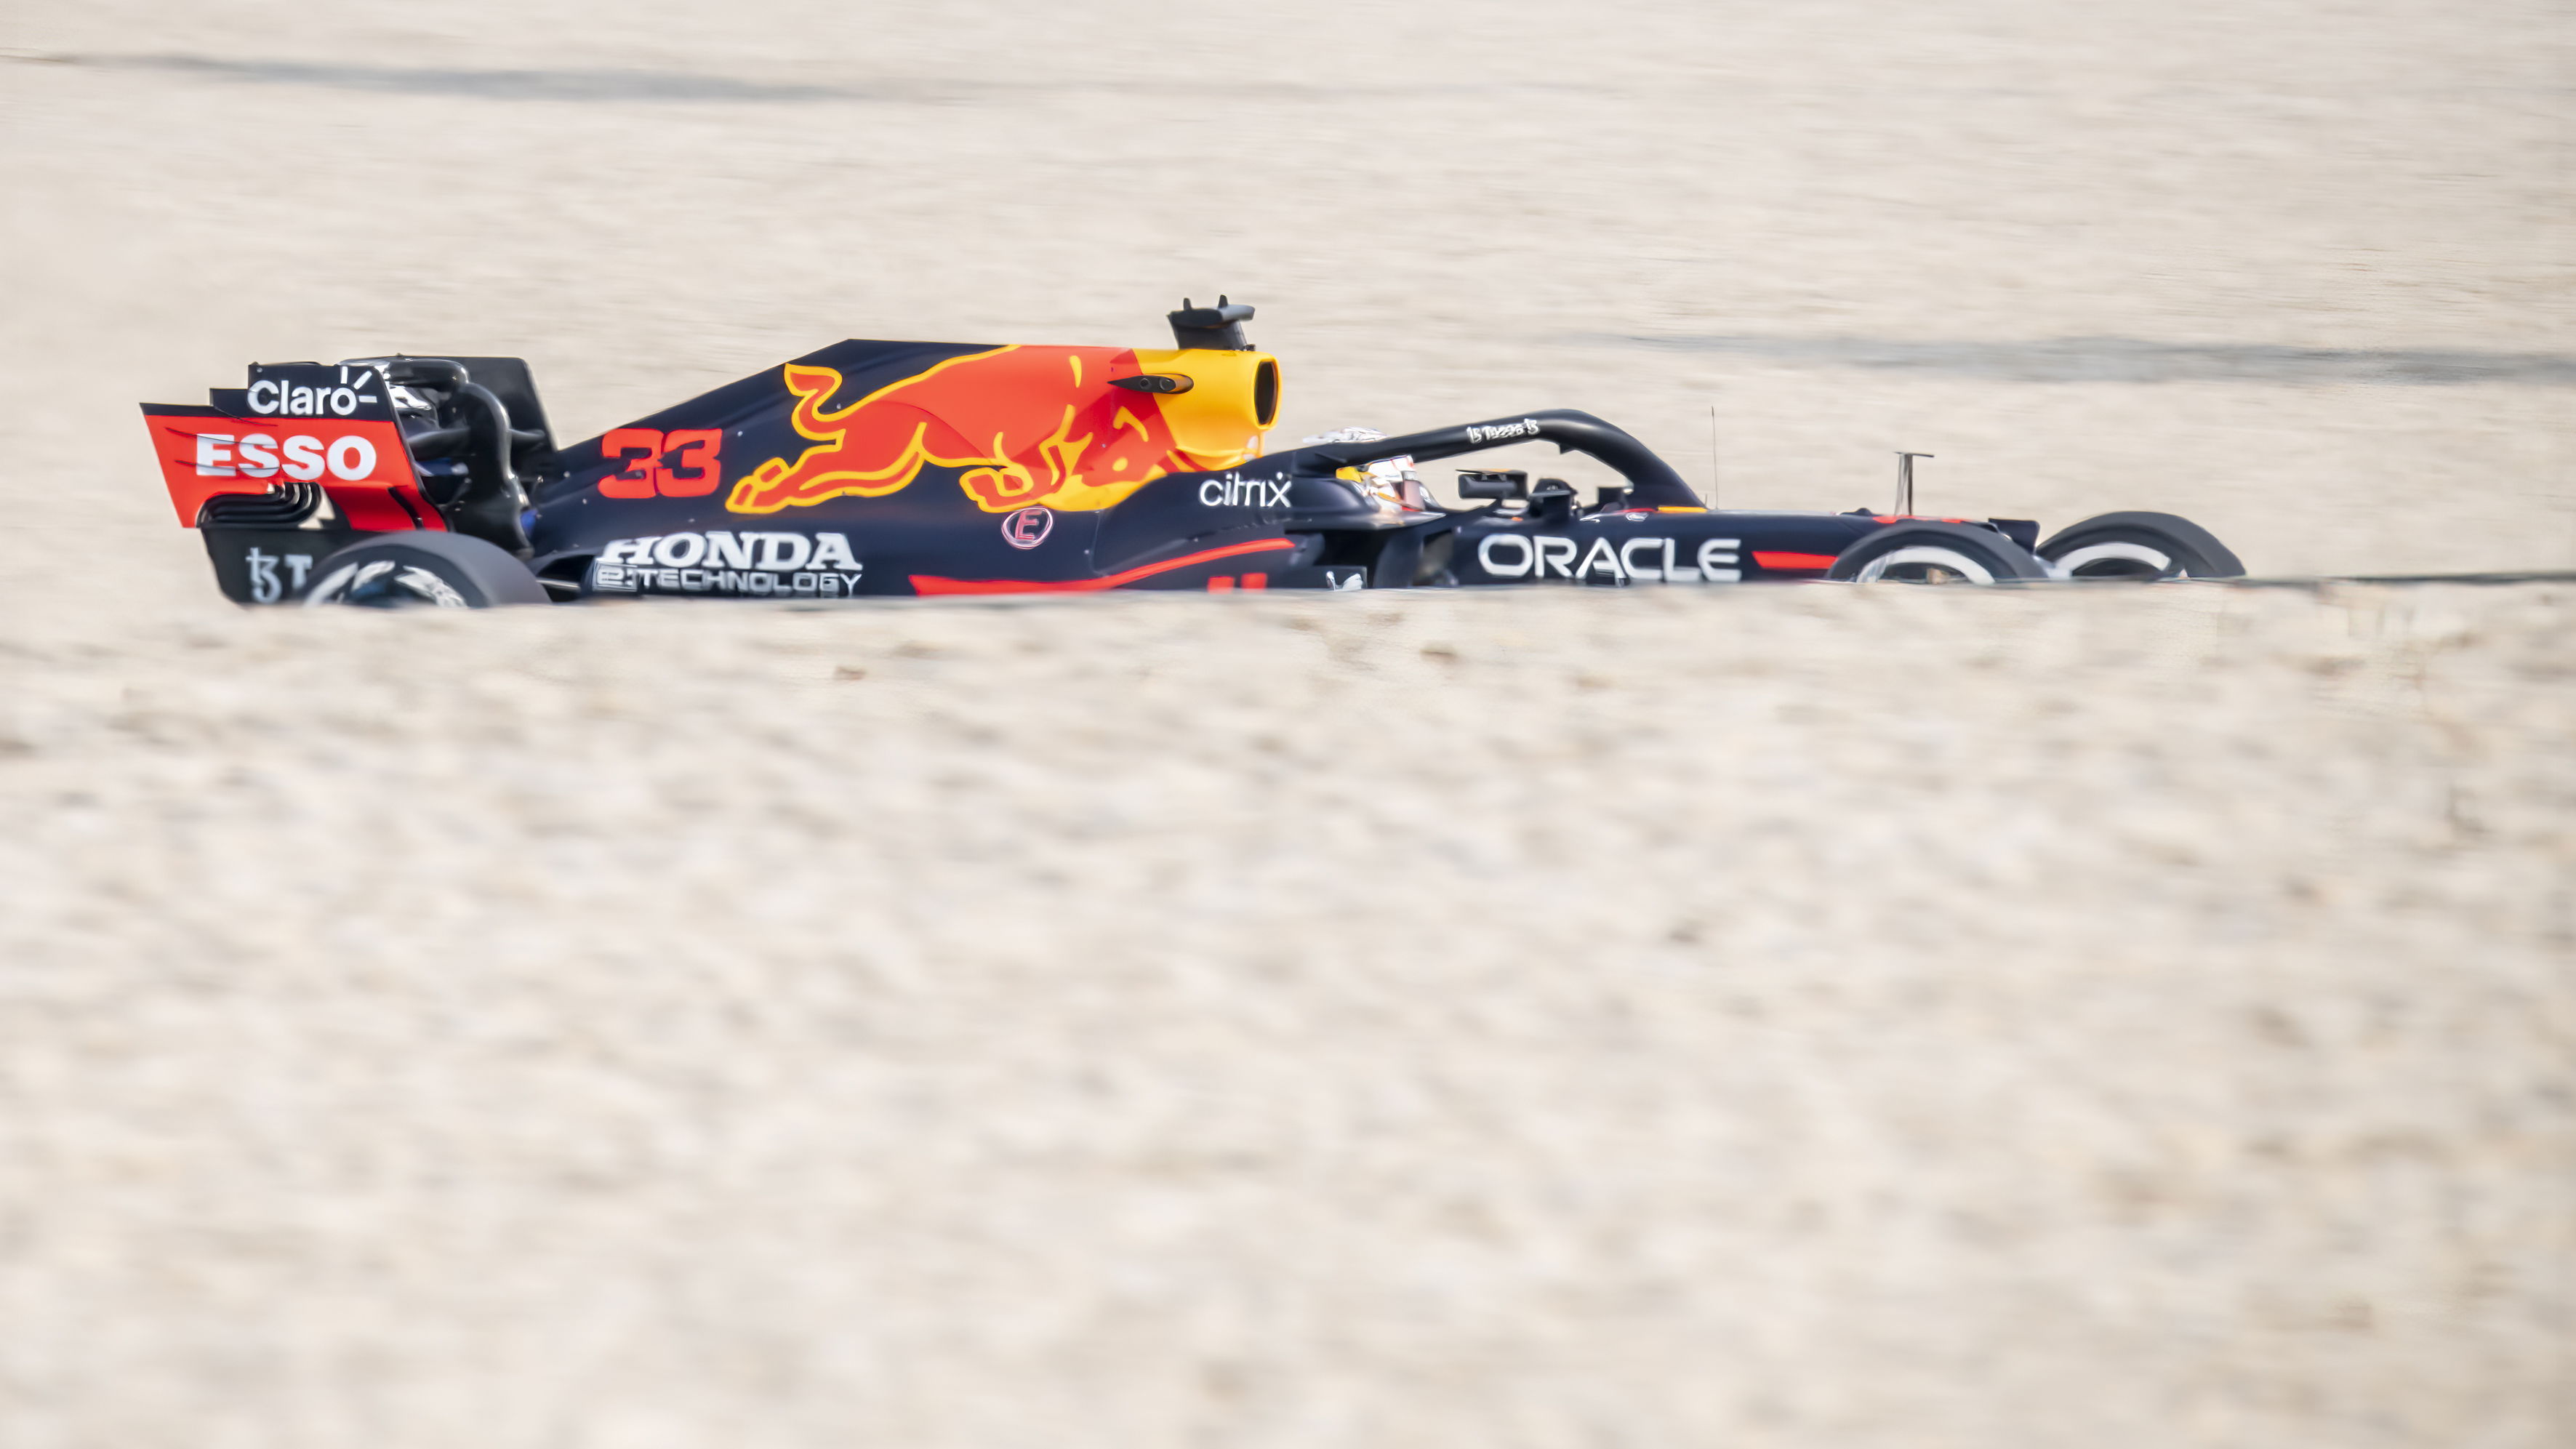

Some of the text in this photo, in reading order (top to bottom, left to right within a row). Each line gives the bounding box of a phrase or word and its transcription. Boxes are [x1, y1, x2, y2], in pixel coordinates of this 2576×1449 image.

[246, 378, 358, 416] Claro
[196, 433, 377, 481] ESSO
[598, 428, 723, 499] 33
[1199, 473, 1292, 507] citrix
[599, 531, 863, 571] HONDA
[1478, 534, 1742, 583] ORACLE
